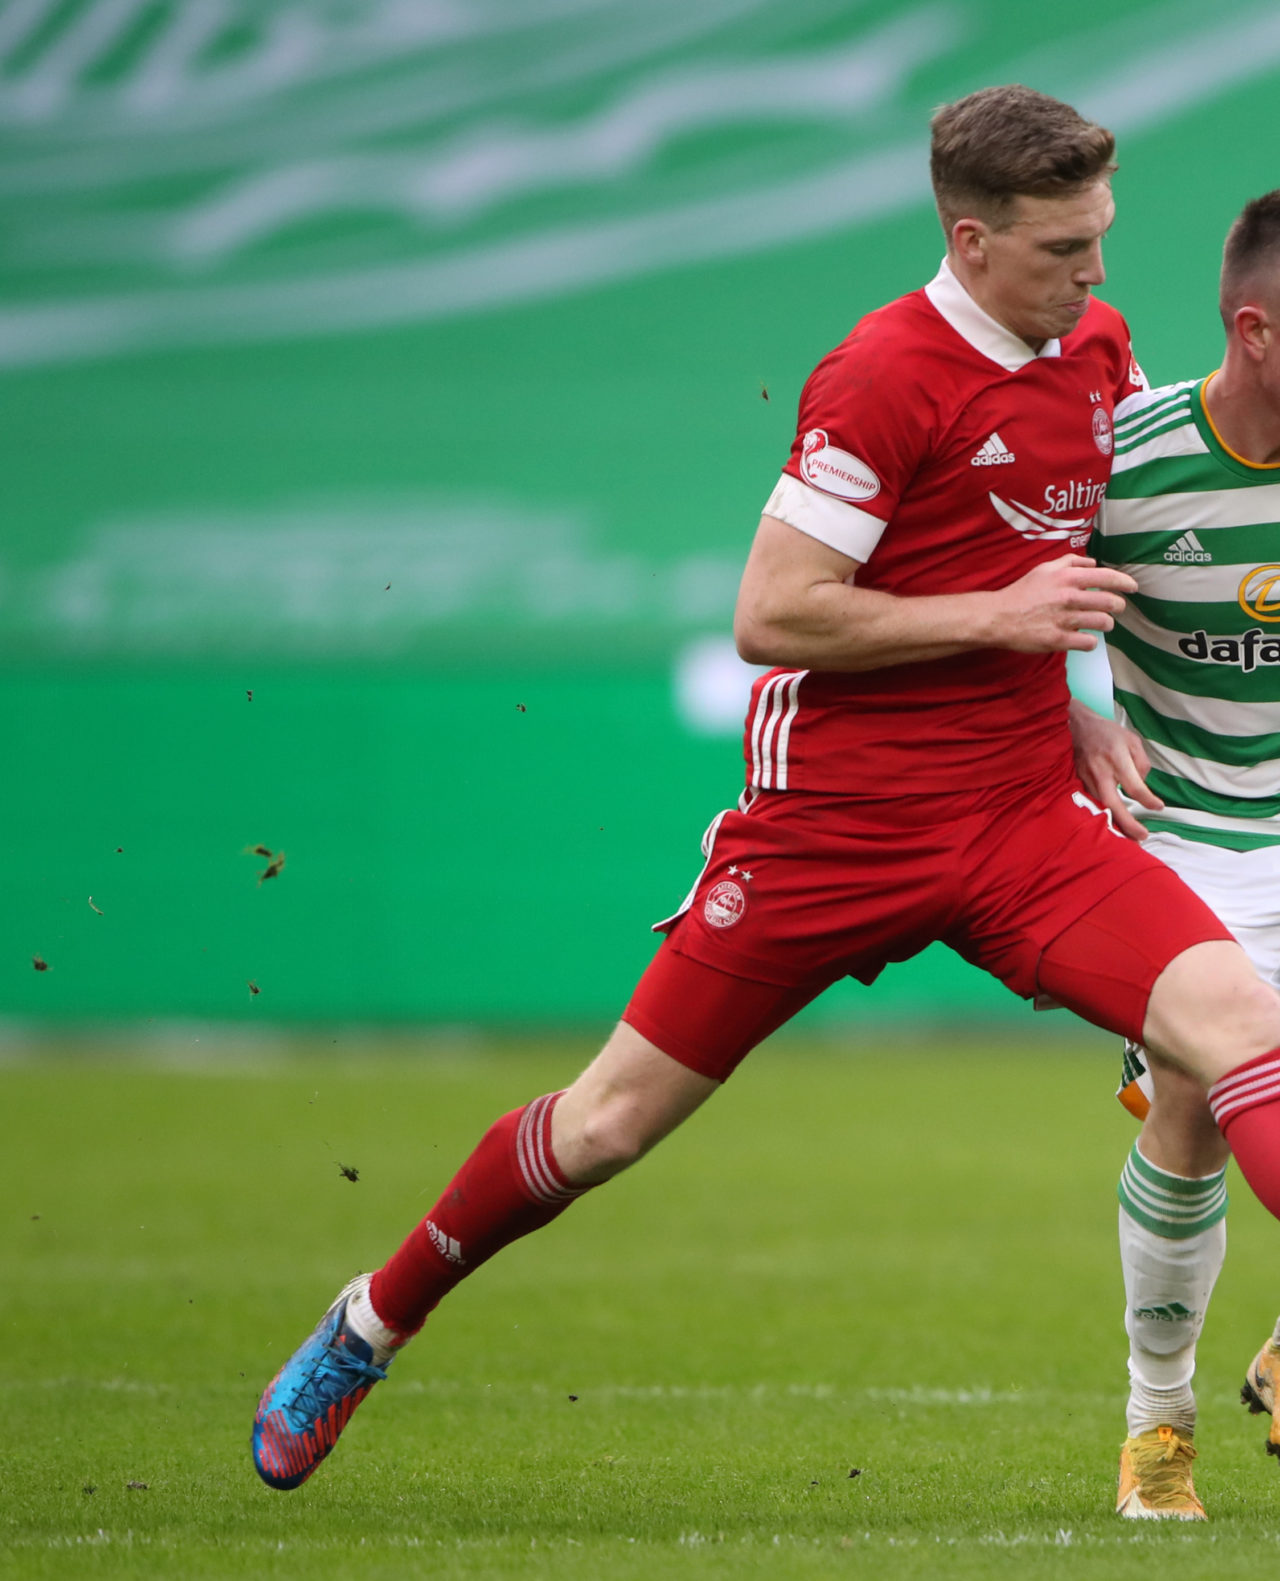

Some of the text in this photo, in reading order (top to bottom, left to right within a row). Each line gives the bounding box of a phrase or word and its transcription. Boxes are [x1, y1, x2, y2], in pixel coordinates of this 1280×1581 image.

[971, 453, 1016, 466] adidas
[811, 458, 876, 491] PREMIERSHIP
[1043, 478, 1107, 514] Saltire
[1163, 551, 1212, 563] adidas
